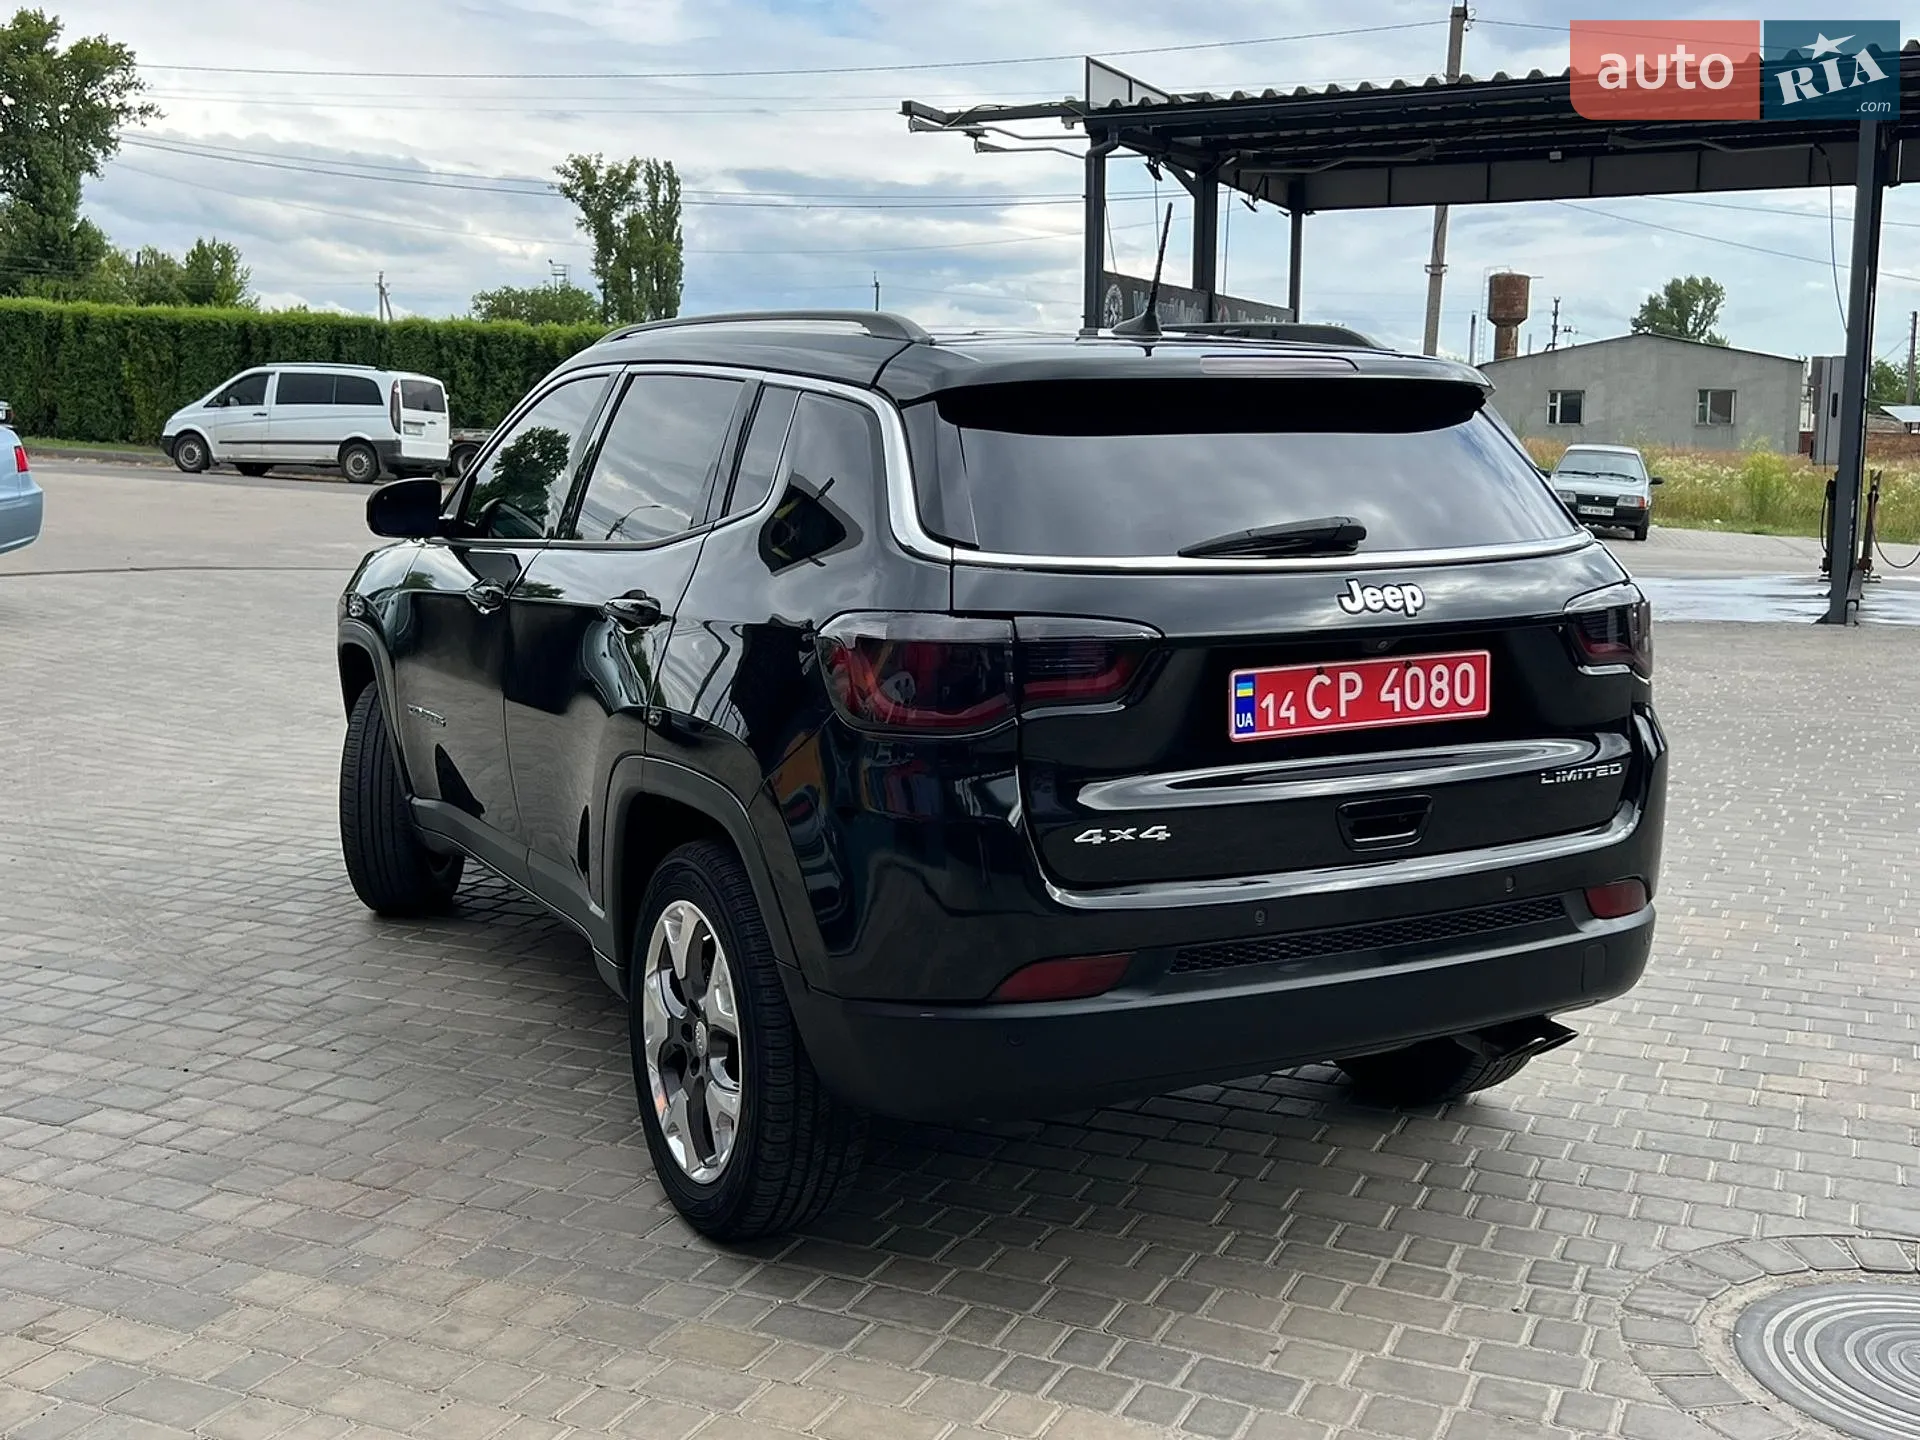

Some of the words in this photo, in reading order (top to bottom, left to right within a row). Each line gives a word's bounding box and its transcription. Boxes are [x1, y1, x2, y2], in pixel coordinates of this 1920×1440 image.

[1337, 579, 1425, 617] Jeep
[1260, 690, 1296, 727] 14
[1306, 671, 1363, 720] CP
[1379, 662, 1476, 713] 4080
[1236, 713, 1254, 728] UA
[1540, 762, 1623, 784] LIMITED
